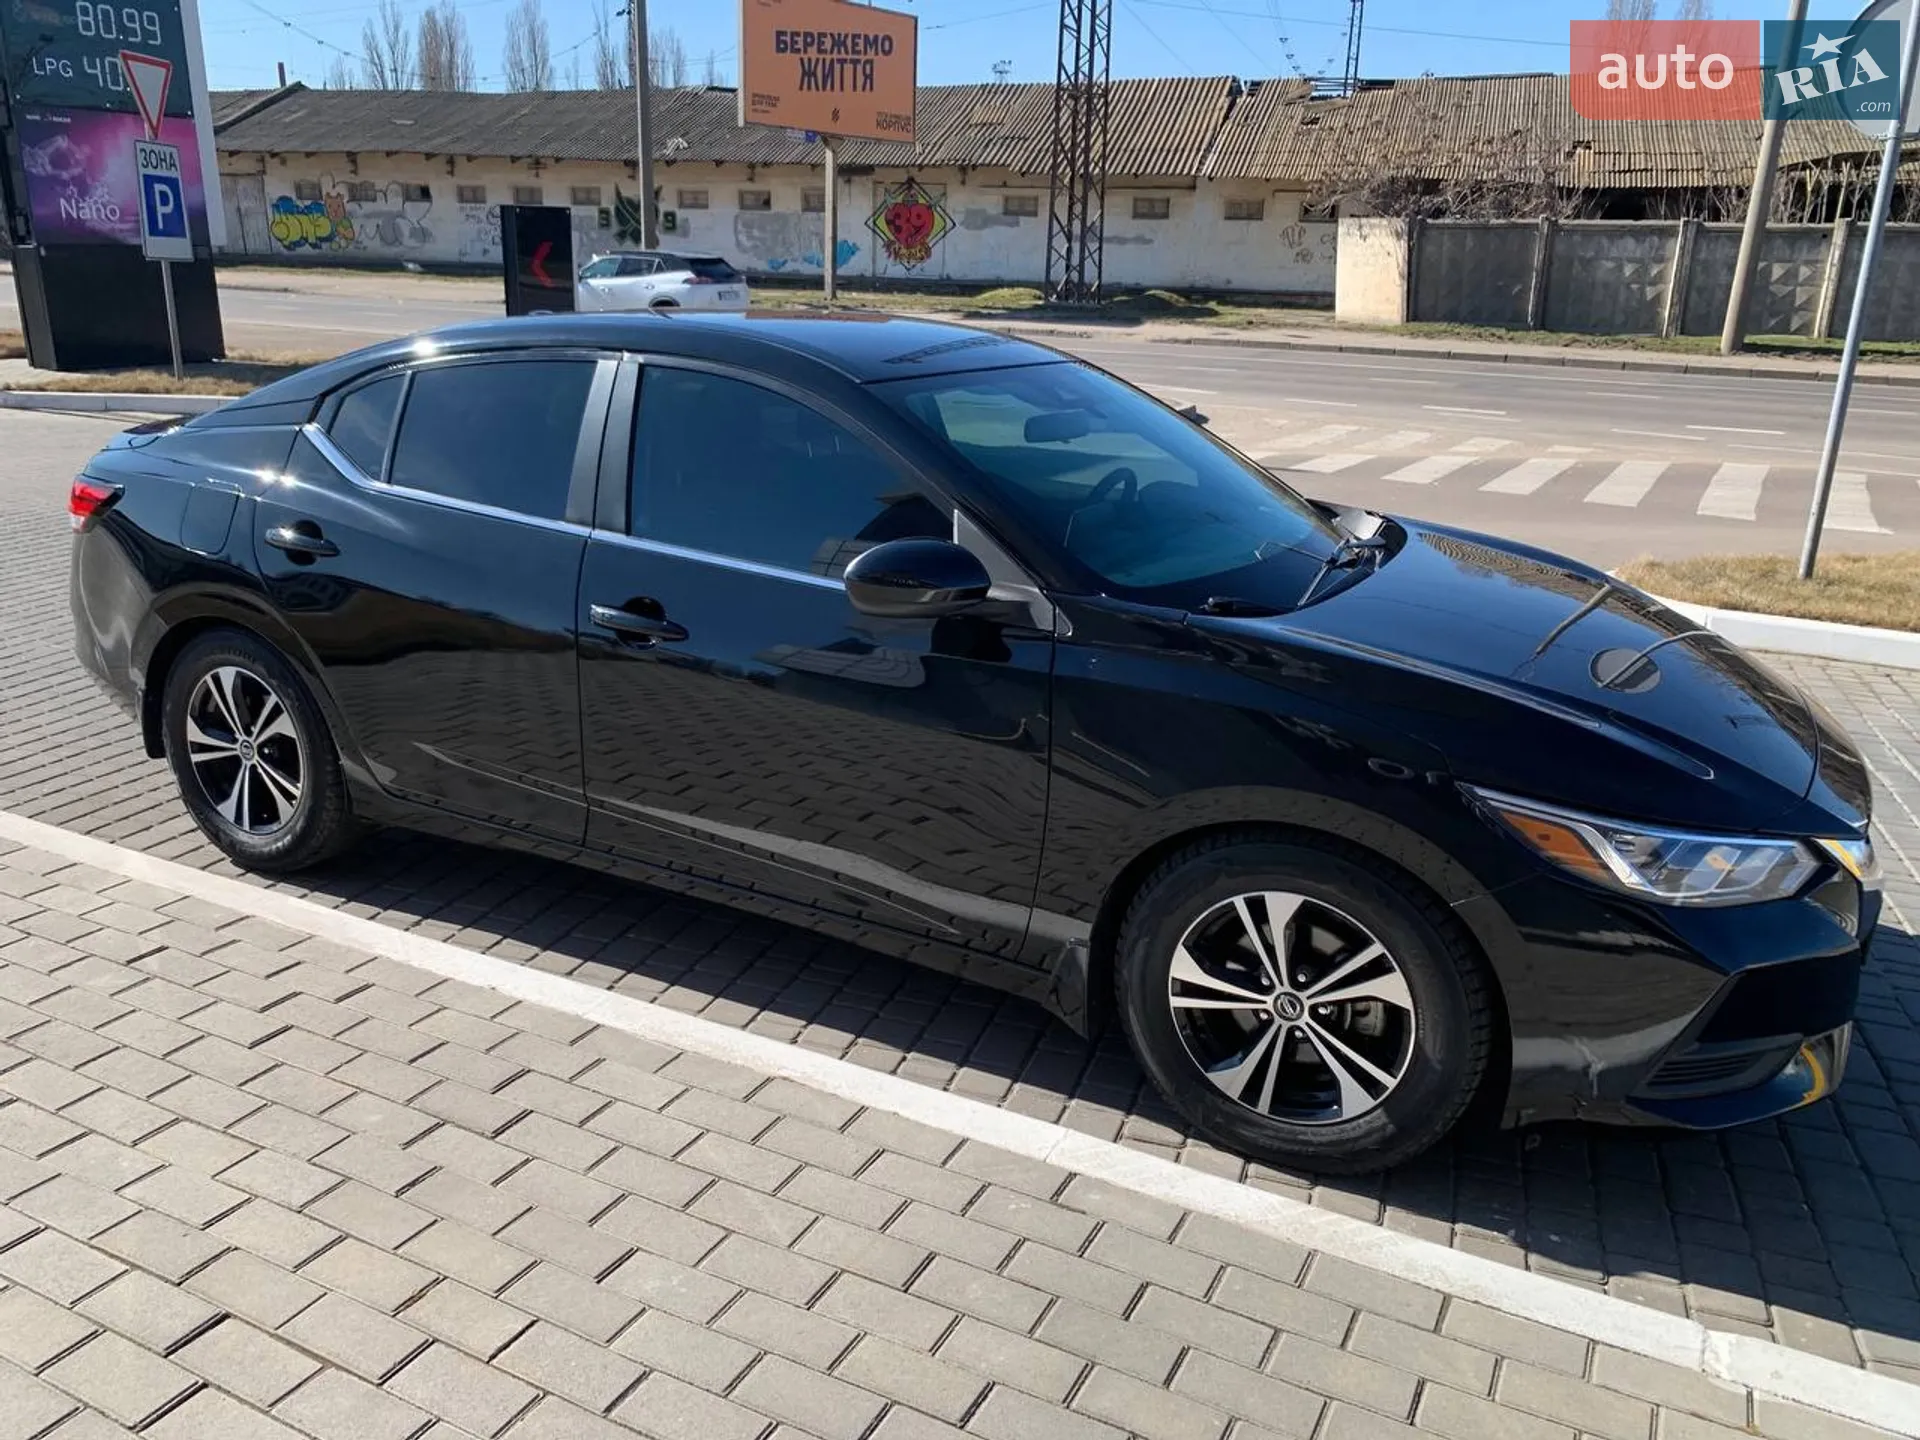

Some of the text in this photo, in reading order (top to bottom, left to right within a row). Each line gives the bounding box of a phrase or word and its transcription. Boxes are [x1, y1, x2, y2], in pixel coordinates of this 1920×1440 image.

[75, 1, 162, 45] 80.99
[775, 30, 893, 57] БЕРЕЖЕМО
[32, 56, 74, 78] LPG
[799, 57, 874, 93] ЖИТТЯ
[139, 147, 179, 172] ЗОНА
[59, 196, 120, 221] Nano
[153, 182, 174, 230] P
